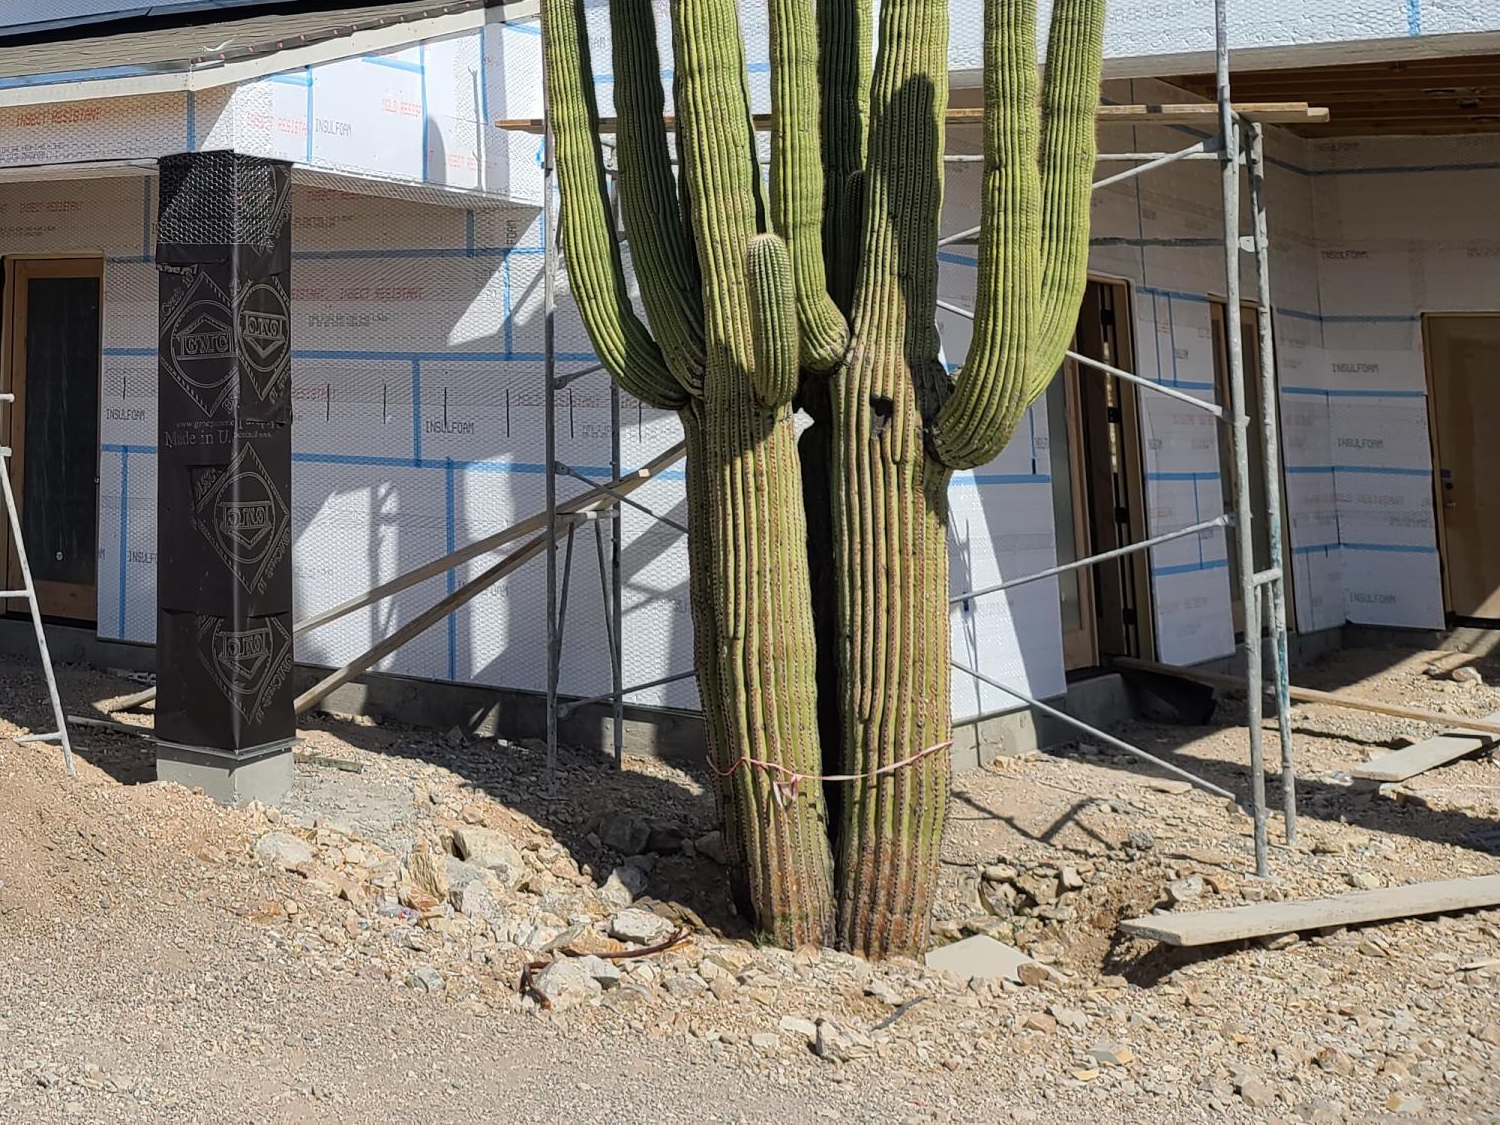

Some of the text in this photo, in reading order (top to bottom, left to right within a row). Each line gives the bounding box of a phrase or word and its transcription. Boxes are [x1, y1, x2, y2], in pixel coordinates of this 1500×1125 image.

[51, 107, 101, 124] RESISTANT
[315, 118, 352, 137] INSULFOAM
[185, 334, 229, 354] GMC
[1332, 363, 1379, 374] INSULFOAM
[106, 408, 146, 421] INSULFOAM
[425, 420, 474, 435] INSULFOAM
[165, 431, 196, 447] Made
[201, 429, 214, 445] in
[1338, 437, 1384, 449] INSULFOAM
[227, 506, 266, 526] GMC
